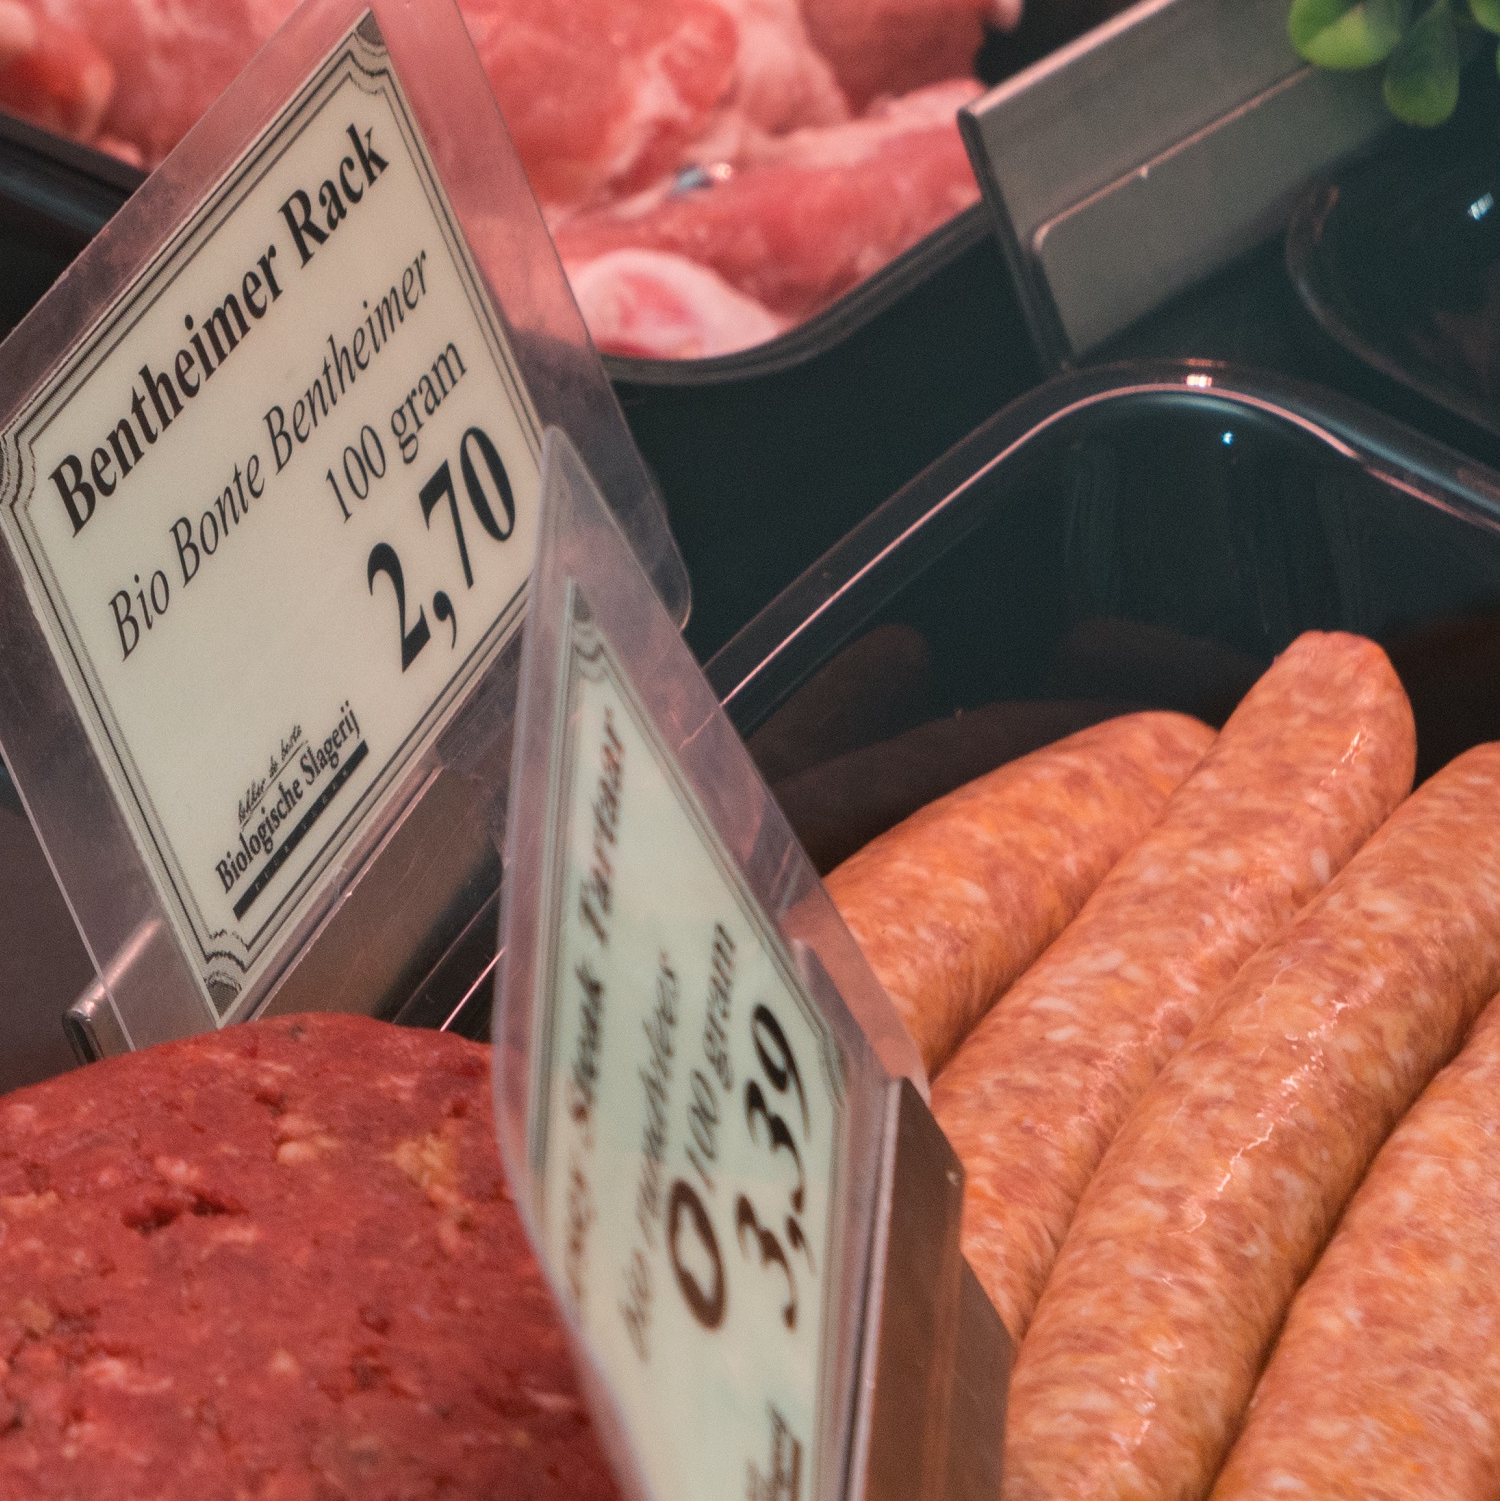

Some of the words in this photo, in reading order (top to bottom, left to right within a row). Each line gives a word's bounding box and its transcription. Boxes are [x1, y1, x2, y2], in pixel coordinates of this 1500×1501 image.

[47, 244, 285, 539] Bentheimer
[276, 122, 391, 270] Rack
[107, 568, 171, 663] Bio
[168, 452, 268, 589] Bonte
[261, 248, 429, 476] Bentheimer
[324, 423, 388, 525] 100
[389, 341, 469, 465] gram
[366, 424, 518, 675] 2,70
[214, 779, 305, 896] Biologische
[299, 699, 361, 787] Slagerij
[685, 1067, 720, 1194] 100
[703, 921, 737, 1094] gram
[734, 1003, 818, 1332] 3,39
